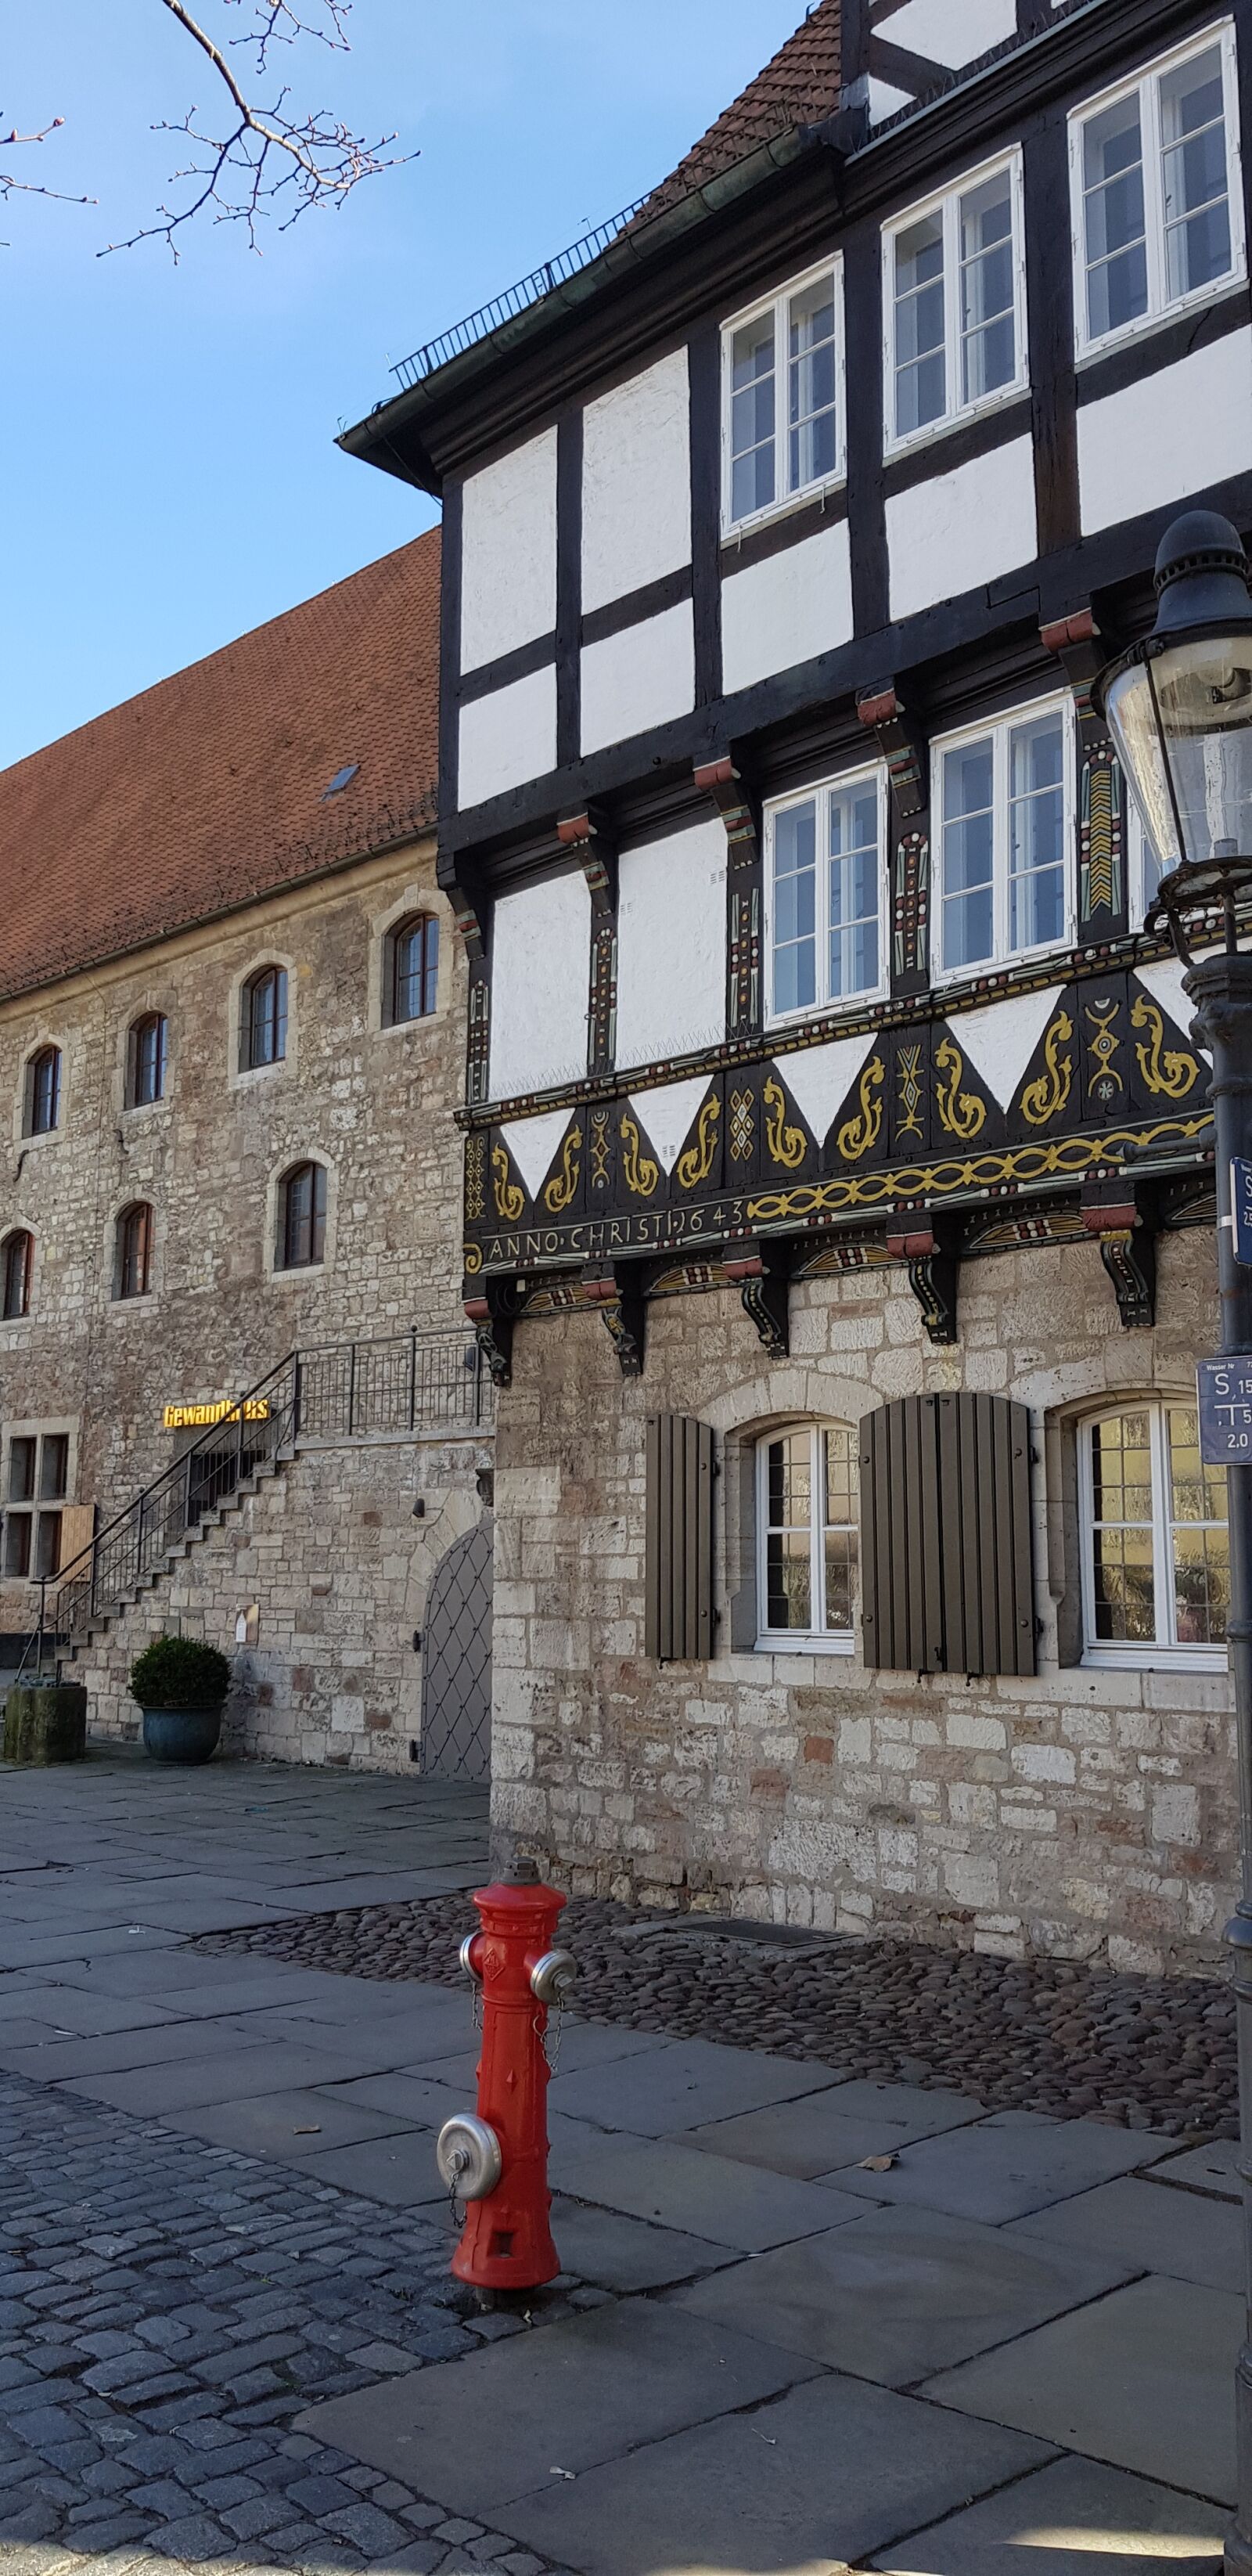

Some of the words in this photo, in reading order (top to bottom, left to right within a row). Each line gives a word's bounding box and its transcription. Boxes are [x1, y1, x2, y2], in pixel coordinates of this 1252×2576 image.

[489, 1232, 559, 1260] ANNO
[570, 1209, 672, 1250] CHRISTI
[1214, 1373, 1229, 1395] S
